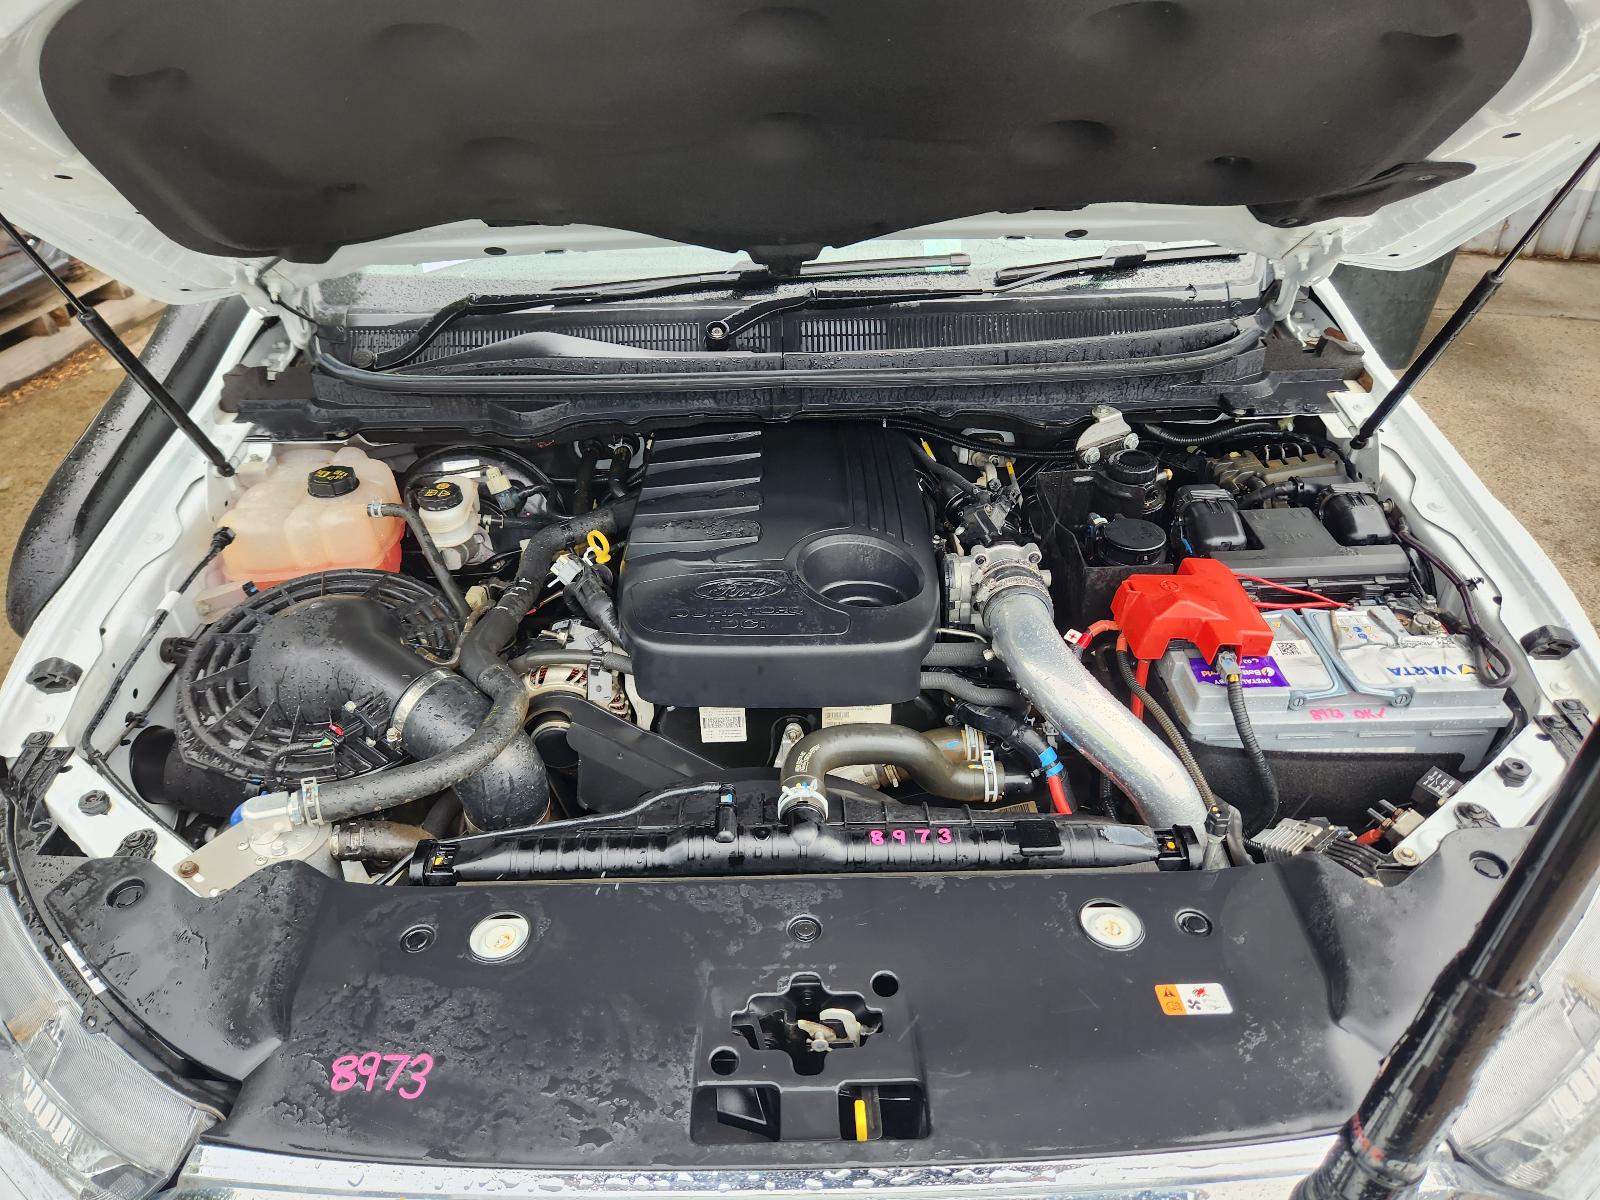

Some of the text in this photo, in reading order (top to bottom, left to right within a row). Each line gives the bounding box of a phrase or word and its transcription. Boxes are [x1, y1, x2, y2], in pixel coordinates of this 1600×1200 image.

[707, 581, 767, 598] Ford
[1386, 665, 1456, 677] VARTA
[870, 827, 952, 846] 8973
[330, 1051, 433, 1099] 8973
